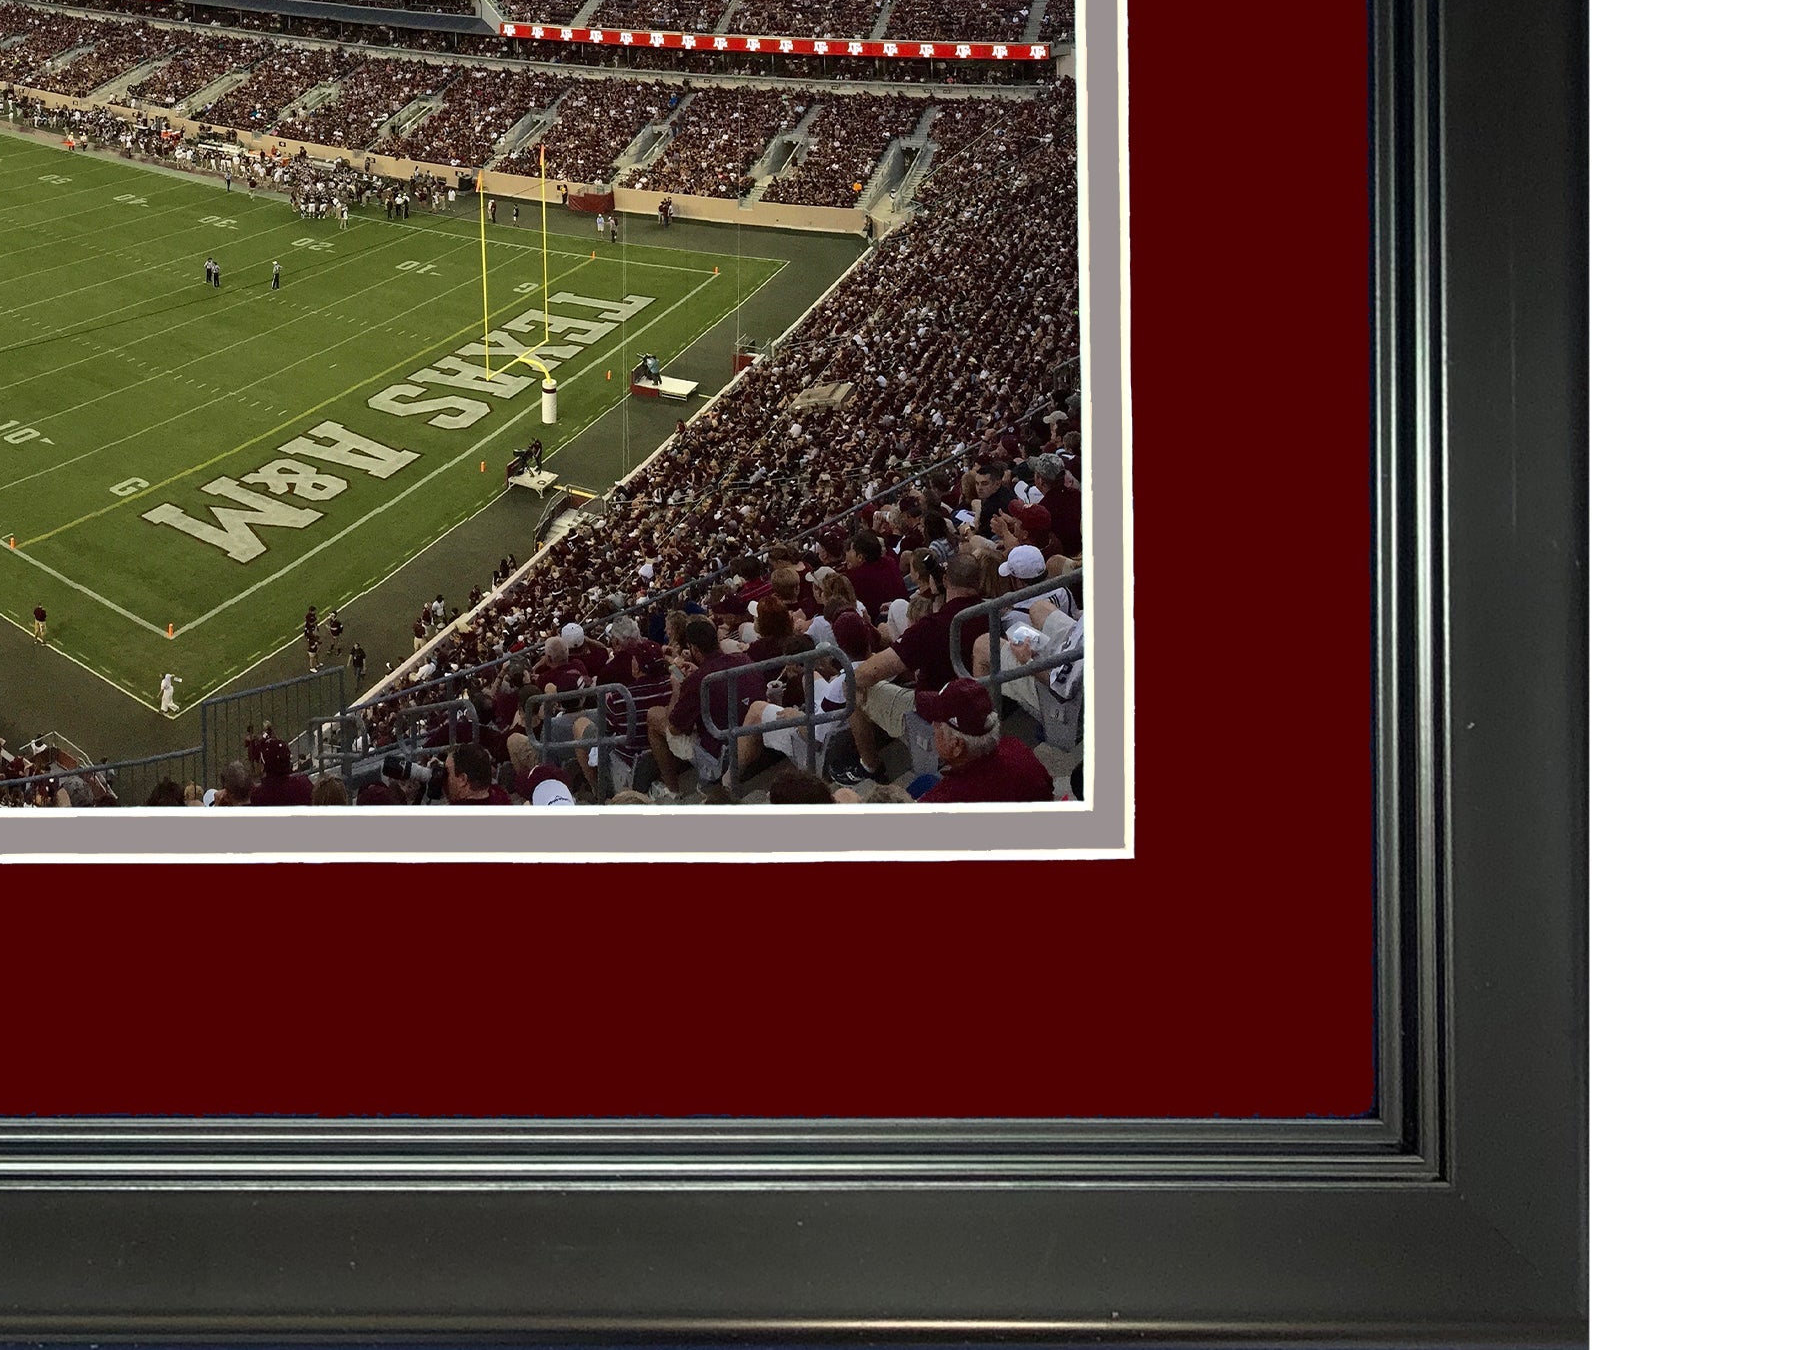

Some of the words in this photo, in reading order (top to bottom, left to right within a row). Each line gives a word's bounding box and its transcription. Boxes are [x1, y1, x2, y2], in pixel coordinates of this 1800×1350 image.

[198, 215, 238, 227] 30
[291, 237, 335, 251] 20
[396, 260, 437, 275] 10
[367, 291, 657, 430] TEXAS
[109, 477, 150, 497] G
[142, 420, 422, 564] A&M
